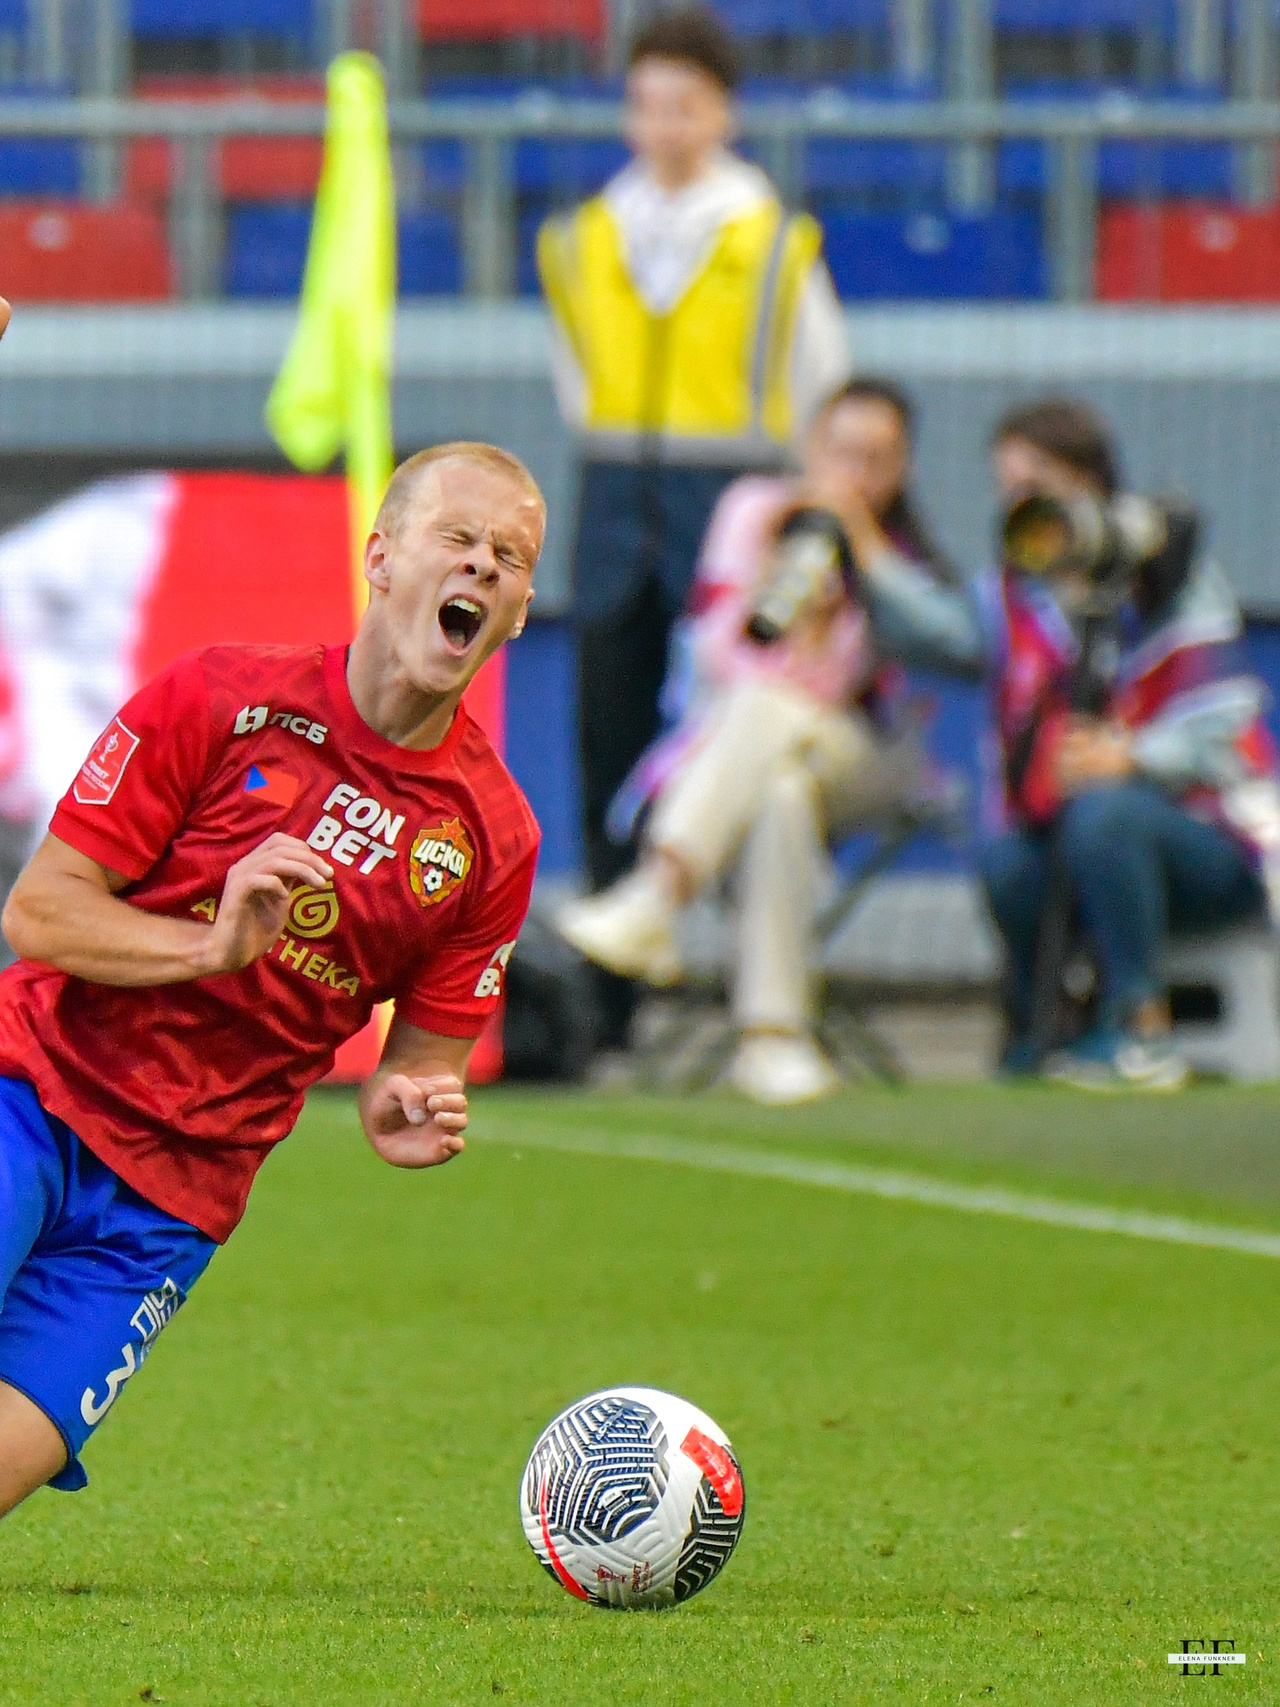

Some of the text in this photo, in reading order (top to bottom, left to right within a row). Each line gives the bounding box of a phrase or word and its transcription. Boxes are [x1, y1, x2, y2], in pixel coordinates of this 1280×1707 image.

[269, 713, 328, 745] ПСБ
[322, 783, 406, 846] FON
[306, 815, 398, 875] BET
[414, 838, 466, 878] ЦСКА
